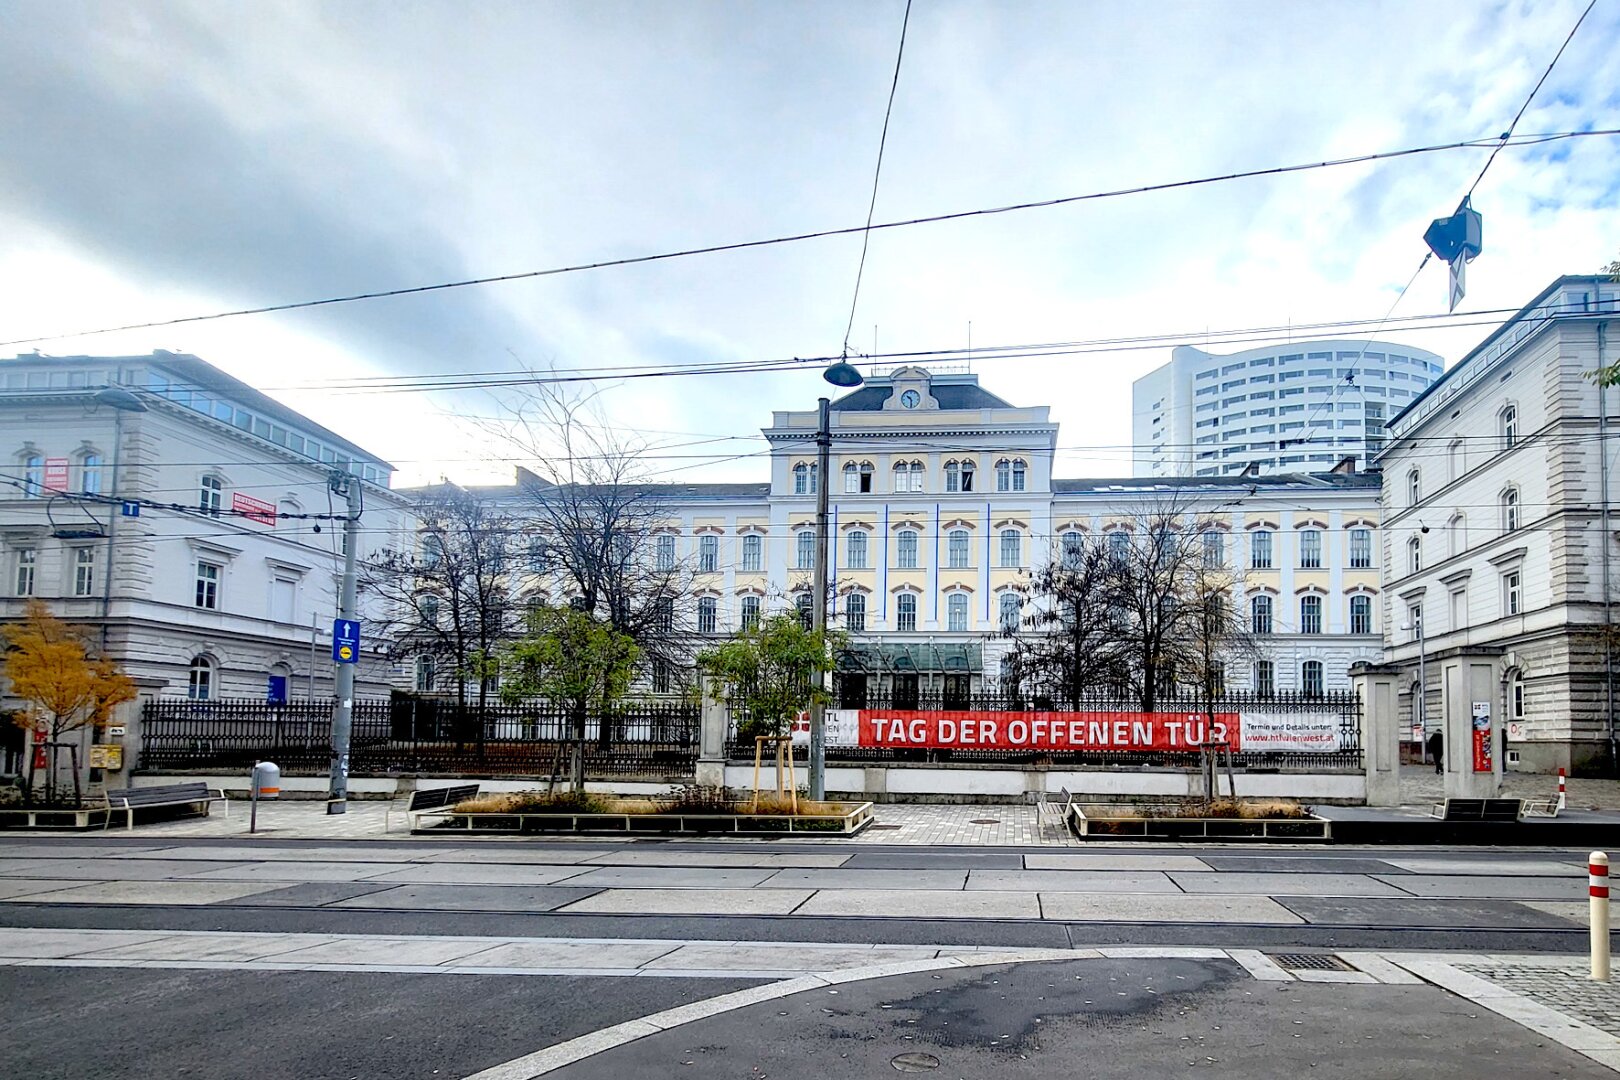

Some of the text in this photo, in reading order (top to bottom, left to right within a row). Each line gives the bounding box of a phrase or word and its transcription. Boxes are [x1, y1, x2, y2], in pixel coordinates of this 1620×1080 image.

[125, 502, 137, 515] T
[826, 712, 839, 722] TL
[825, 725, 839, 733] IEN
[871, 715, 1228, 746] TAG DER OFFENEN TÜR
[824, 736, 839, 744] EST
[1245, 734, 1335, 742] www.htlwienwest.at
